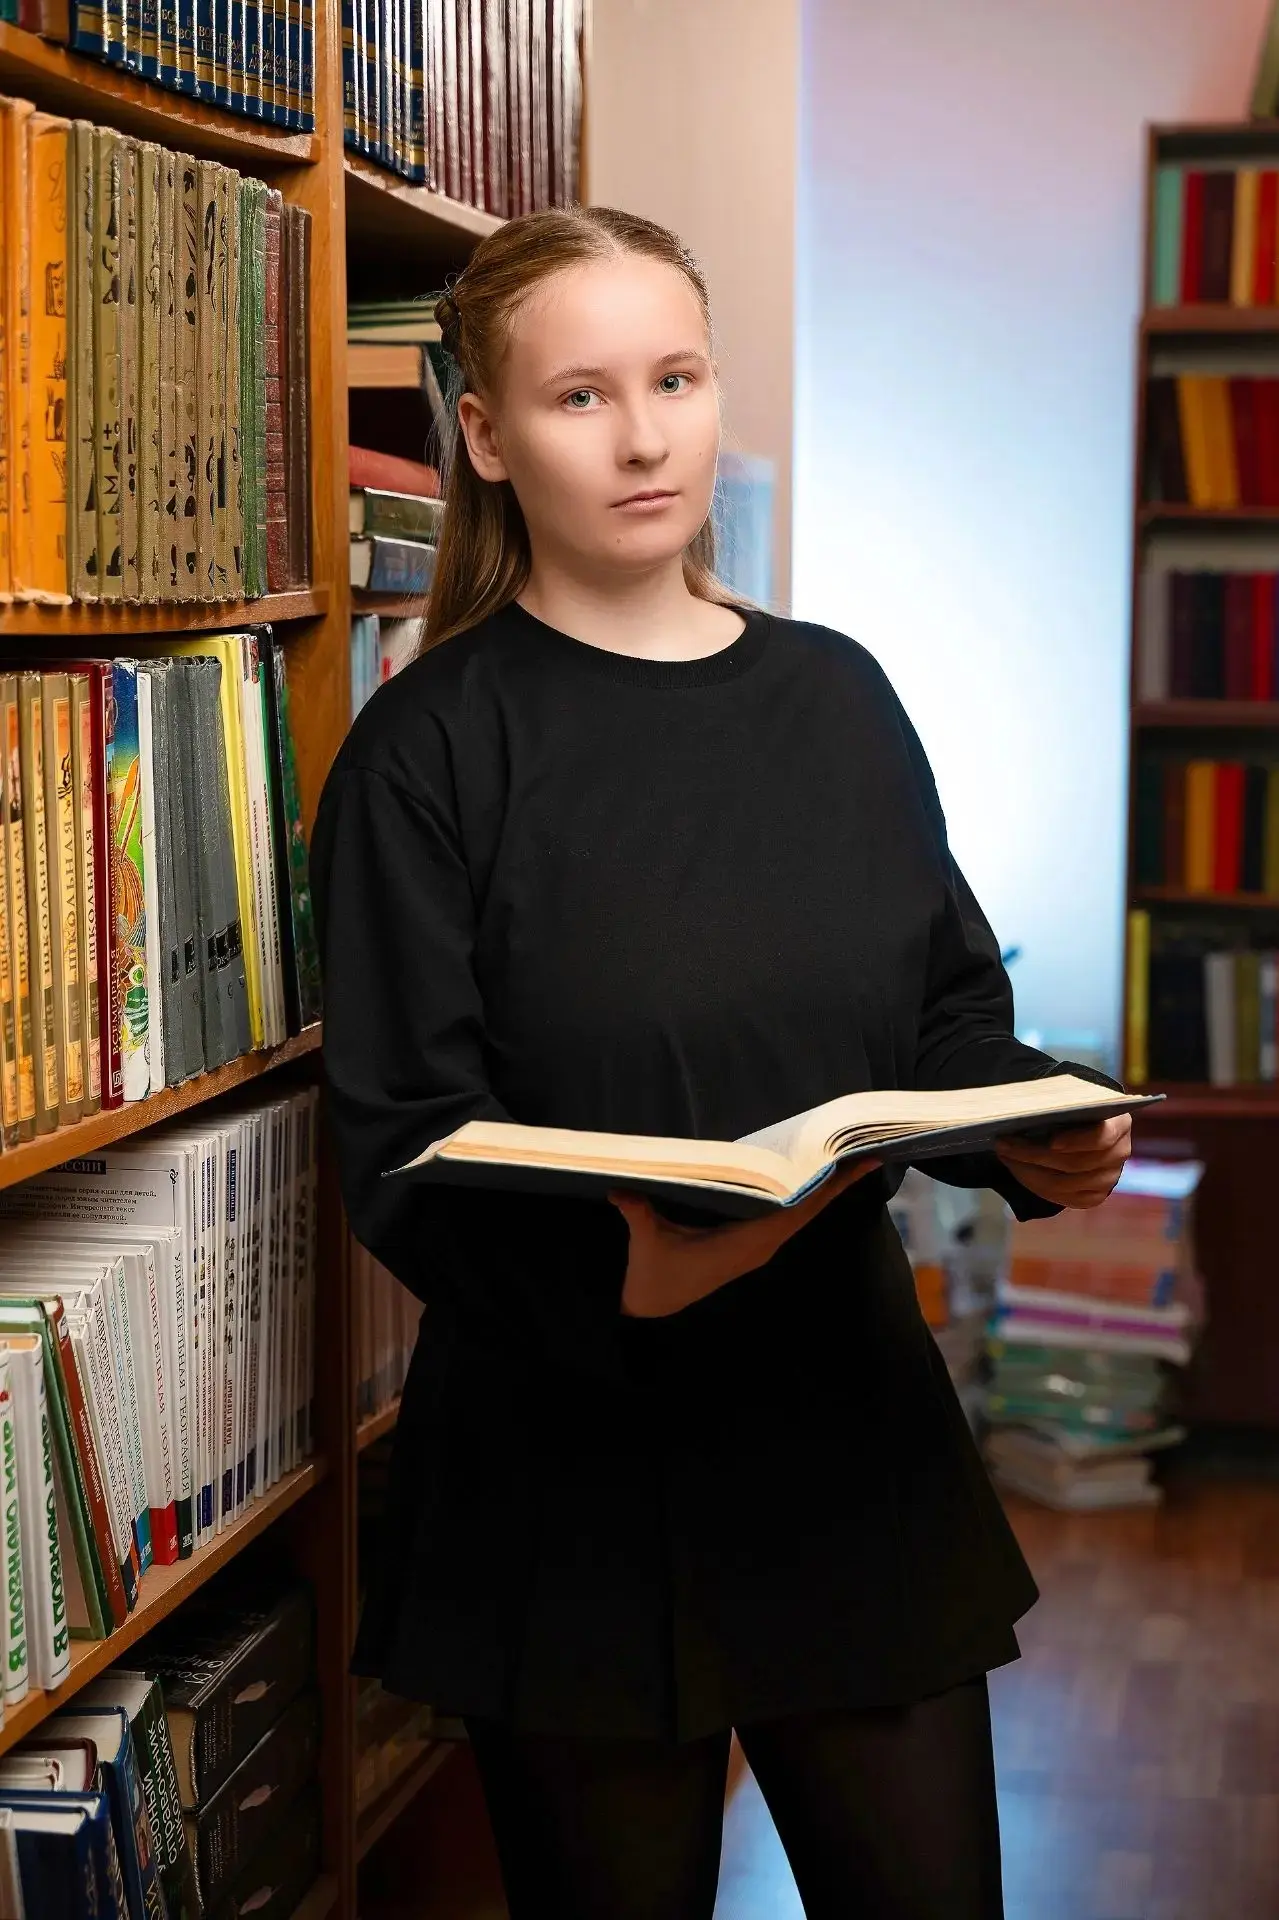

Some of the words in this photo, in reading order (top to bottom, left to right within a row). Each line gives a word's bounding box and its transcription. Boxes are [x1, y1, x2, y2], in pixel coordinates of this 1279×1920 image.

[13, 829, 27, 984] ШКОЛЬНАЯ
[37, 821, 50, 975] ШКОЛЬНАЯ
[63, 820, 78, 971] ШКОЛЬНАЯ
[85, 828, 97, 962] ШКОЛЬНАЯ
[110, 948, 119, 1056] ВСЕМИРНАЯ
[57, 1161, 102, 1173] ОССИИ
[70, 1203, 114, 1212] Интересный
[78, 1187, 99, 1196] серия
[134, 1190, 157, 1198] детей,
[81, 1213, 127, 1221] популярной.
[95, 1294, 115, 1403] УДИВИТЕЛЬНАЯ
[174, 1251, 186, 1390] УДИВИТЕЛЬНАЯ
[148, 1261, 166, 1415] УДИВИТЕЛЬНАЯ
[160, 1423, 173, 1502] ЛОГИКА
[3, 1419, 16, 1495] МИР
[41, 1413, 53, 1487] МИР
[179, 1394, 190, 1493] ГЕОГРАФИЯ
[6, 1500, 24, 1640] ПОЗНАЮ
[46, 1488, 66, 1627] ПОЗНАЮ
[8, 1638, 27, 1673] Я
[53, 1627, 69, 1659] Я
[148, 1719, 178, 1865] справочник
[157, 1713, 185, 1851] школьника
